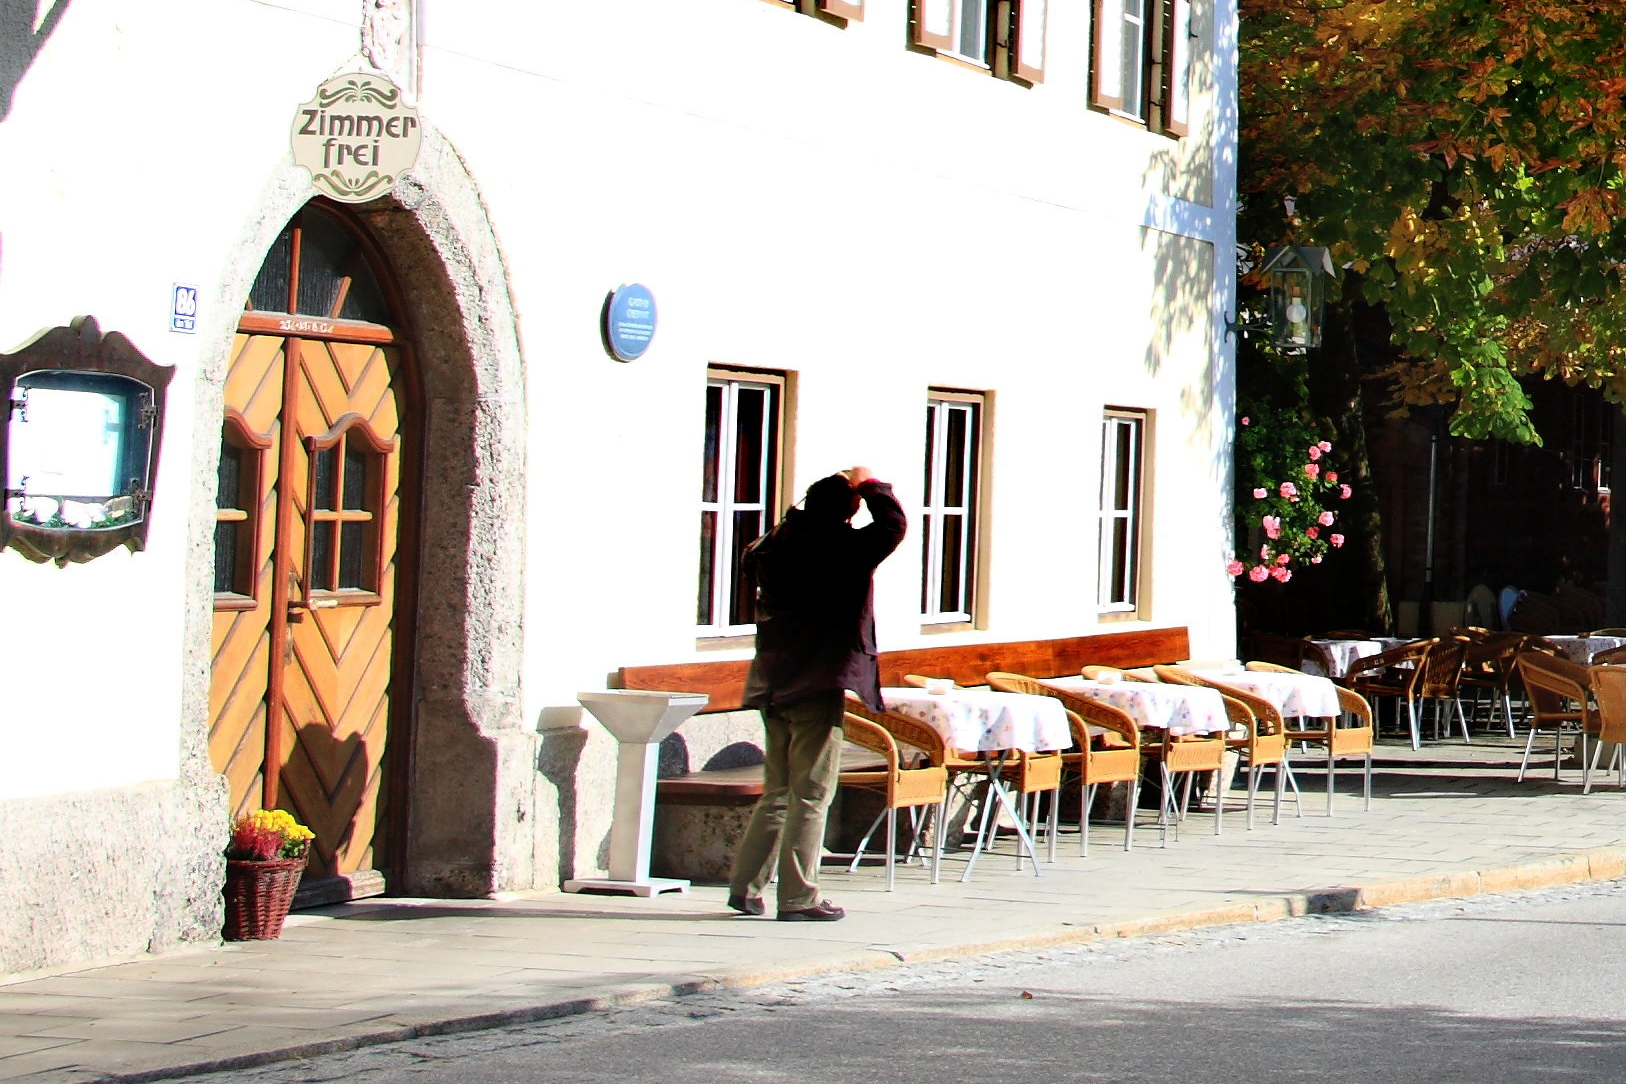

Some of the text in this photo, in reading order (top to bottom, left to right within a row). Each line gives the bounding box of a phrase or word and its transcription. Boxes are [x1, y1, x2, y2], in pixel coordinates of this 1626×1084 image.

[298, 109, 417, 138] Zimmer
[322, 138, 380, 168] frei
[175, 287, 196, 315] 86
